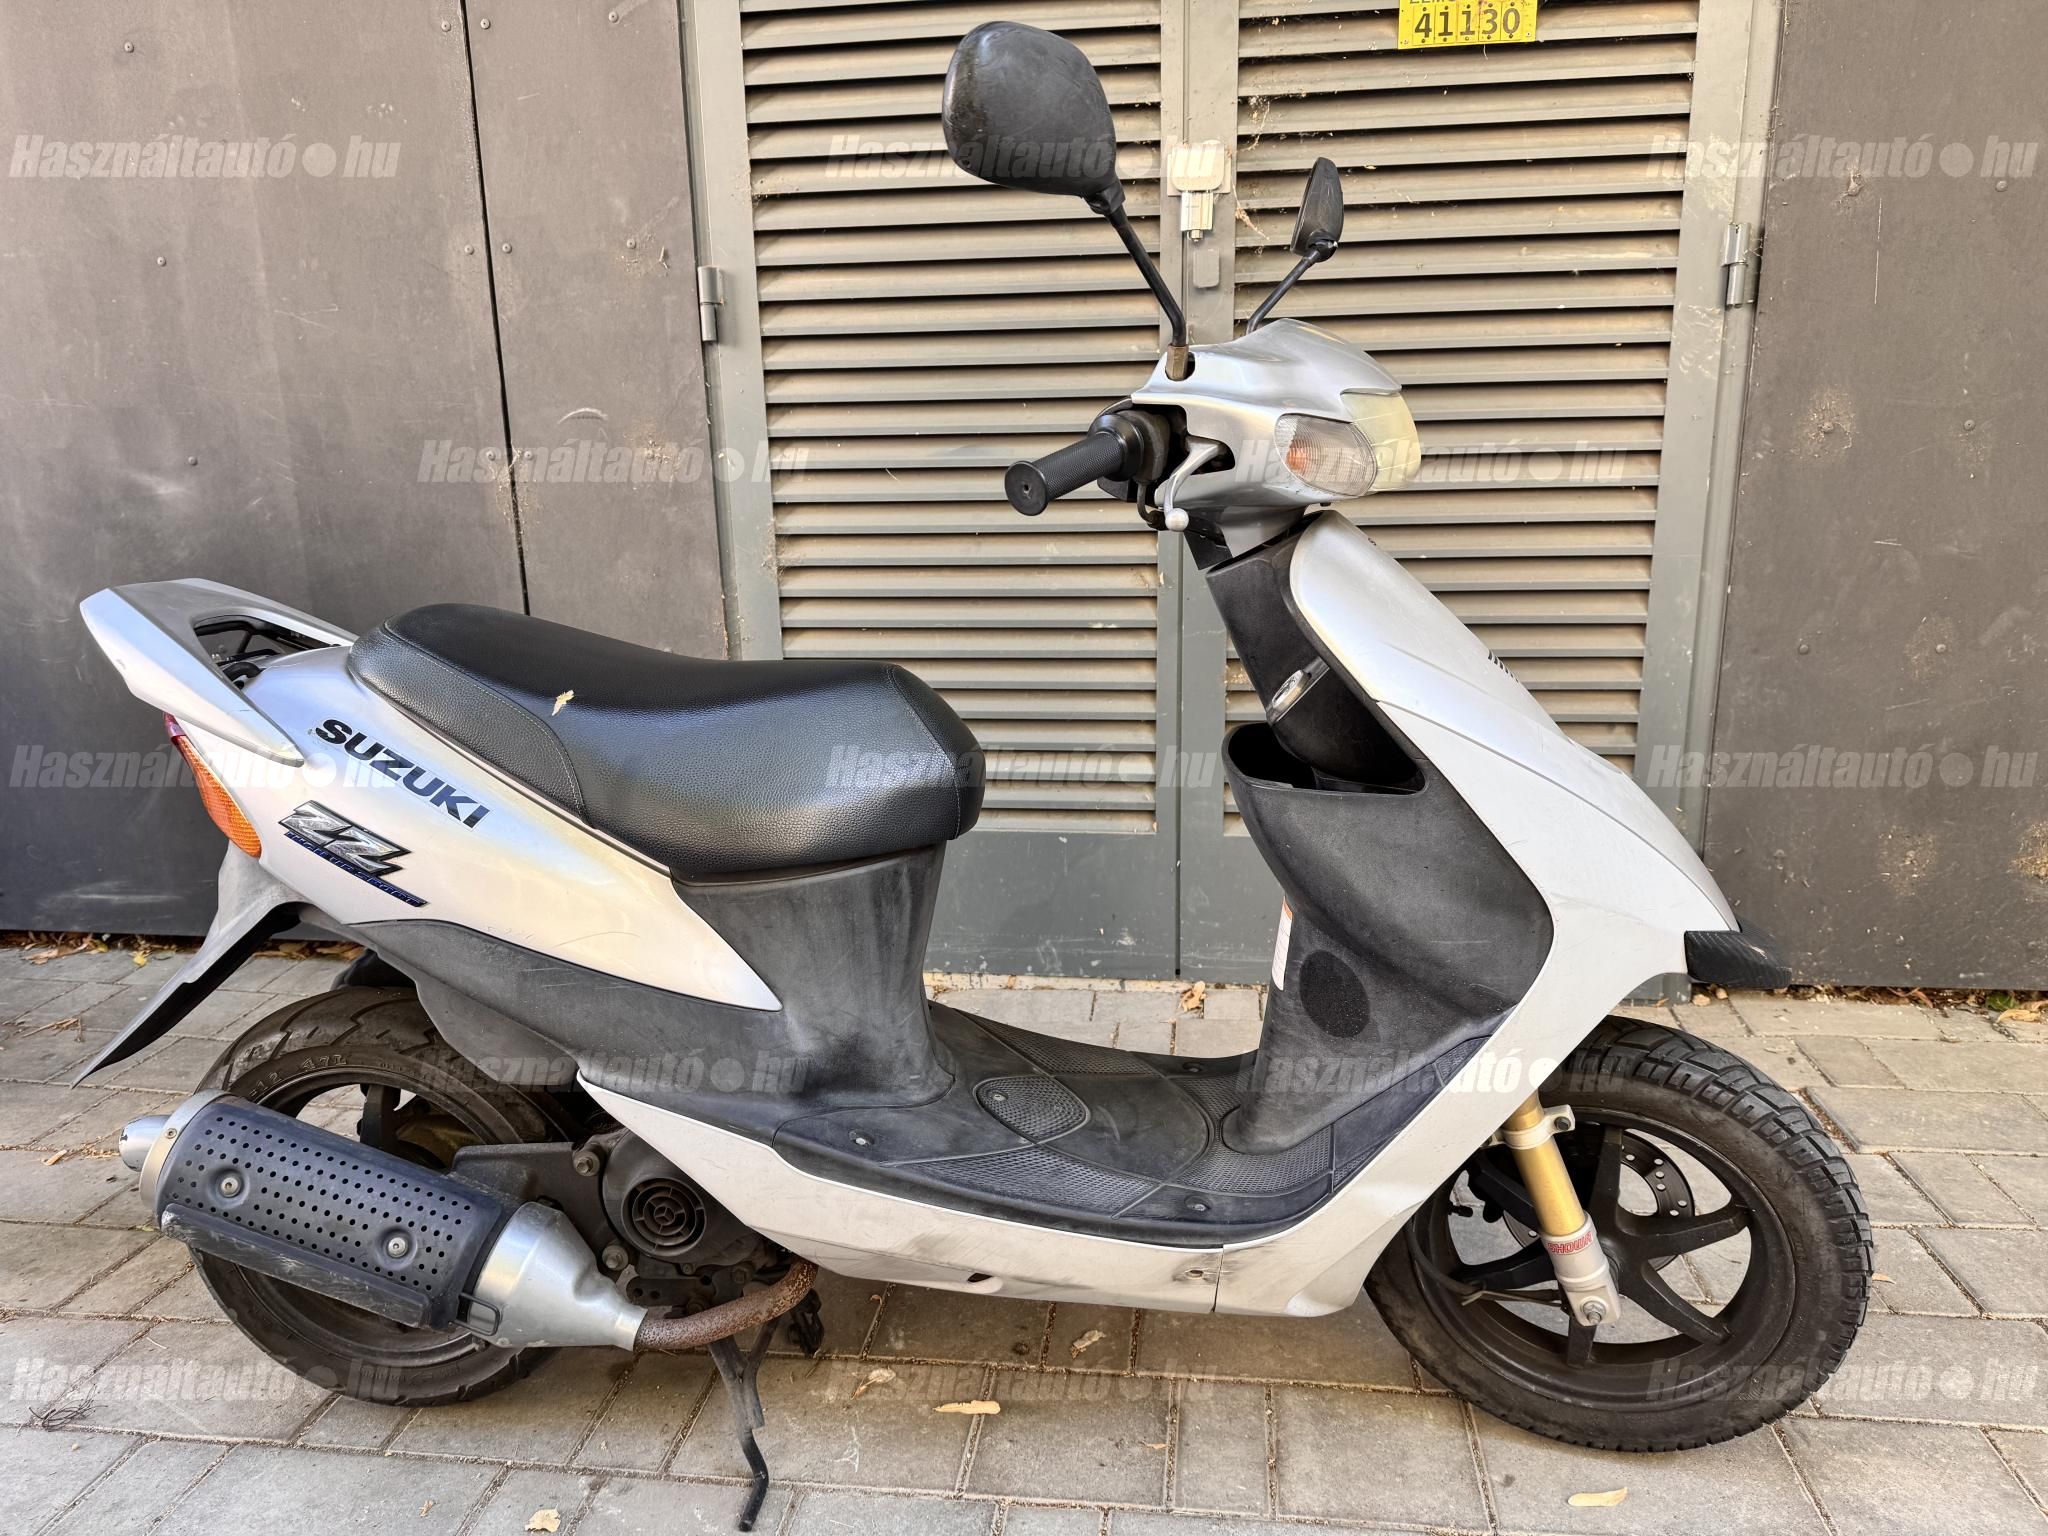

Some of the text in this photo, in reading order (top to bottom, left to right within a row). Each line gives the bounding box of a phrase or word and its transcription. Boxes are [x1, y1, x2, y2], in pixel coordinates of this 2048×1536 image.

[1414, 8, 1521, 38] 41130
[315, 718, 490, 829] SUZUKI
[1548, 1231, 1592, 1254] SHOWA
